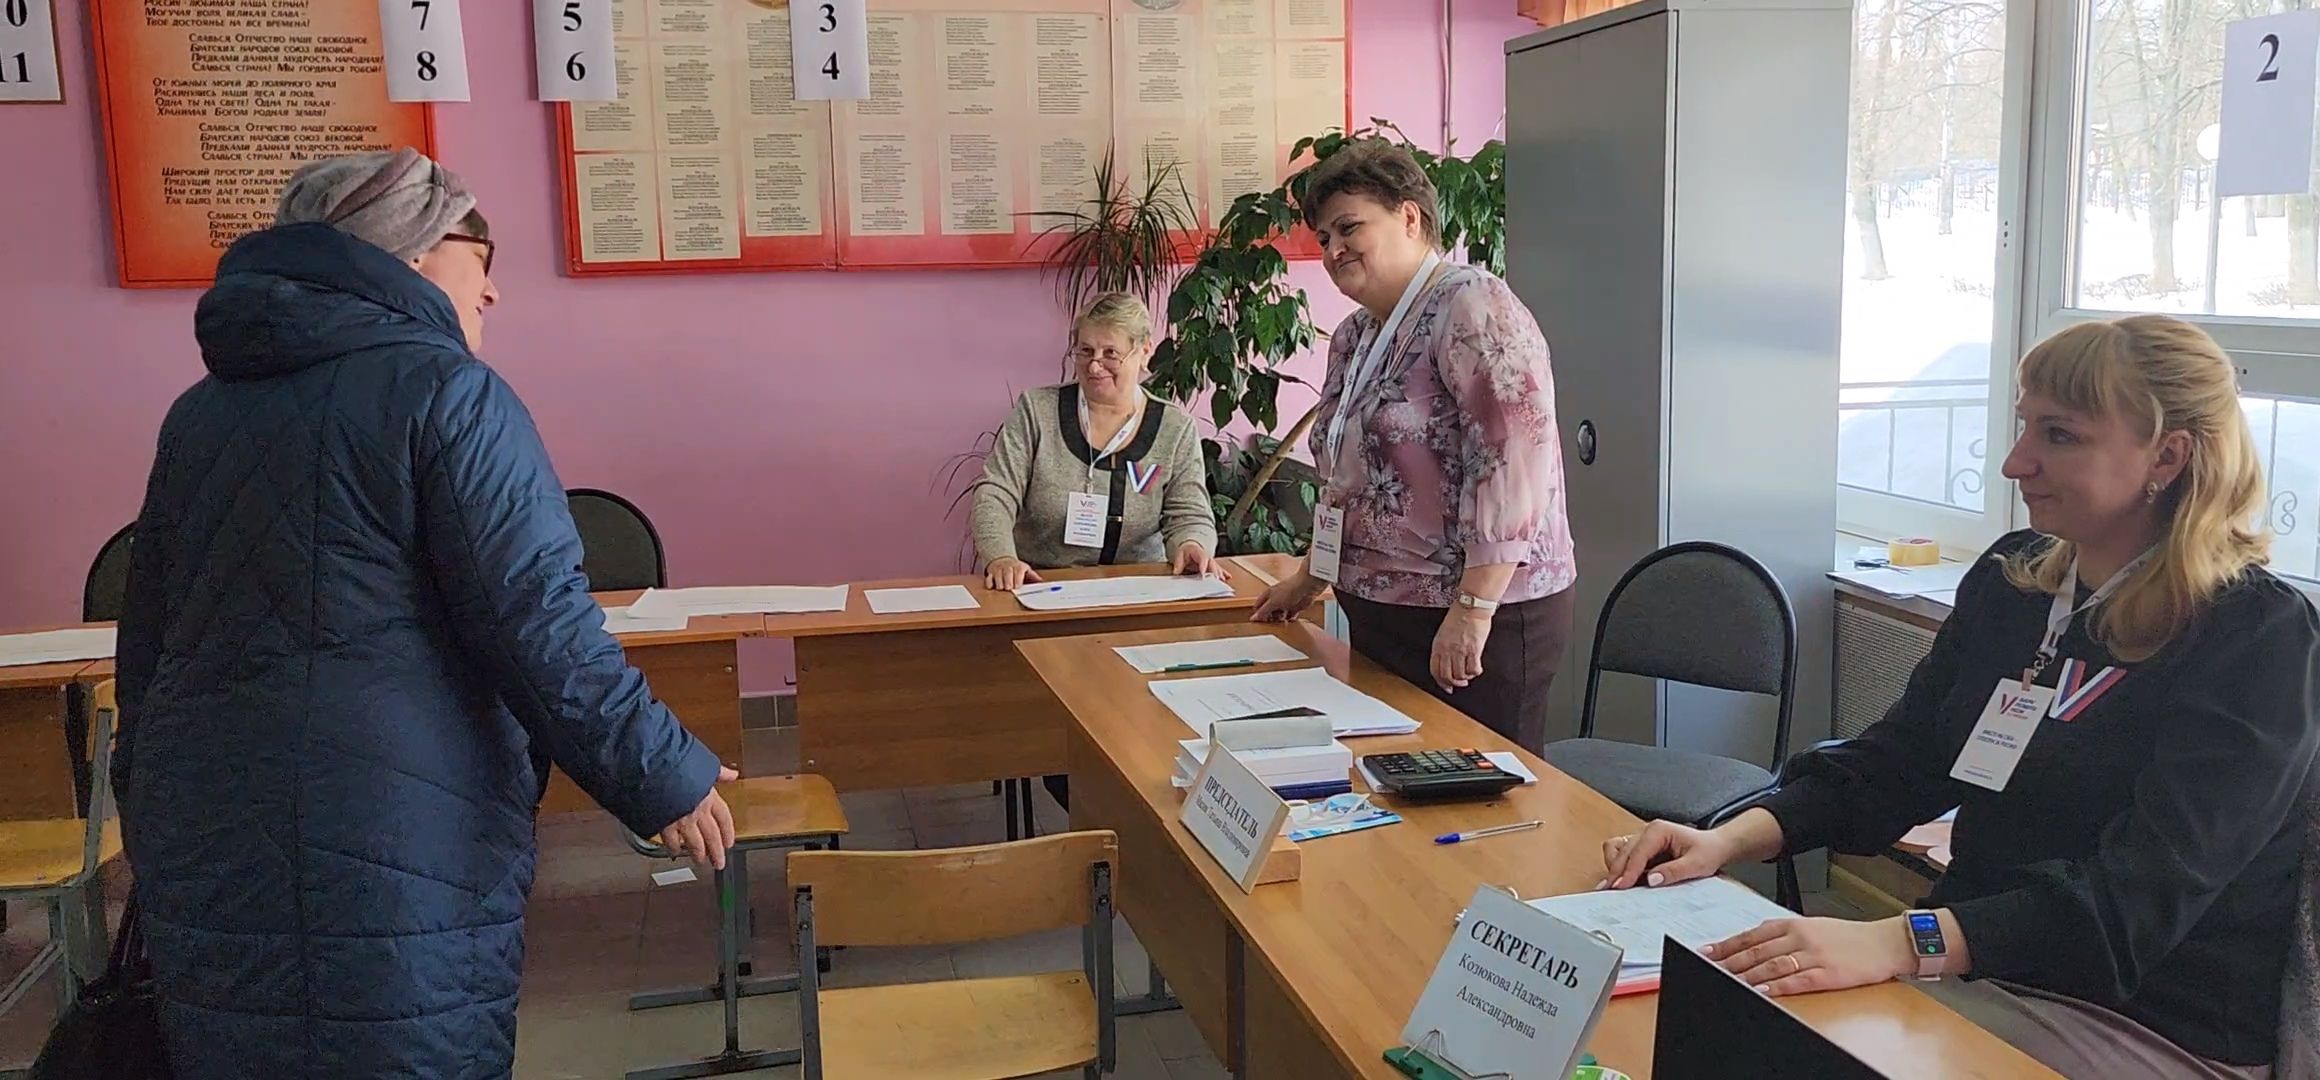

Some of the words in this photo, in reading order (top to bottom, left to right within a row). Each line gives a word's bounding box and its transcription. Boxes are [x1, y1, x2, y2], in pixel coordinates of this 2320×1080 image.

[411, 1, 430, 31] 7
[563, 2, 582, 31] 5
[819, 3, 837, 32] 3
[417, 51, 437, 81] 8
[566, 51, 585, 81] 6
[822, 51, 840, 80] 4
[2256, 34, 2280, 82] 2
[1204, 775, 1258, 839] ПРЕДСЕДАТЕЛЬ
[1470, 920, 1578, 989] СЕКРЕТАРЬ
[1458, 952, 1511, 992] Козюкова
[1511, 980, 1559, 1017] Надежда
[1456, 985, 1536, 1039] Александровна
